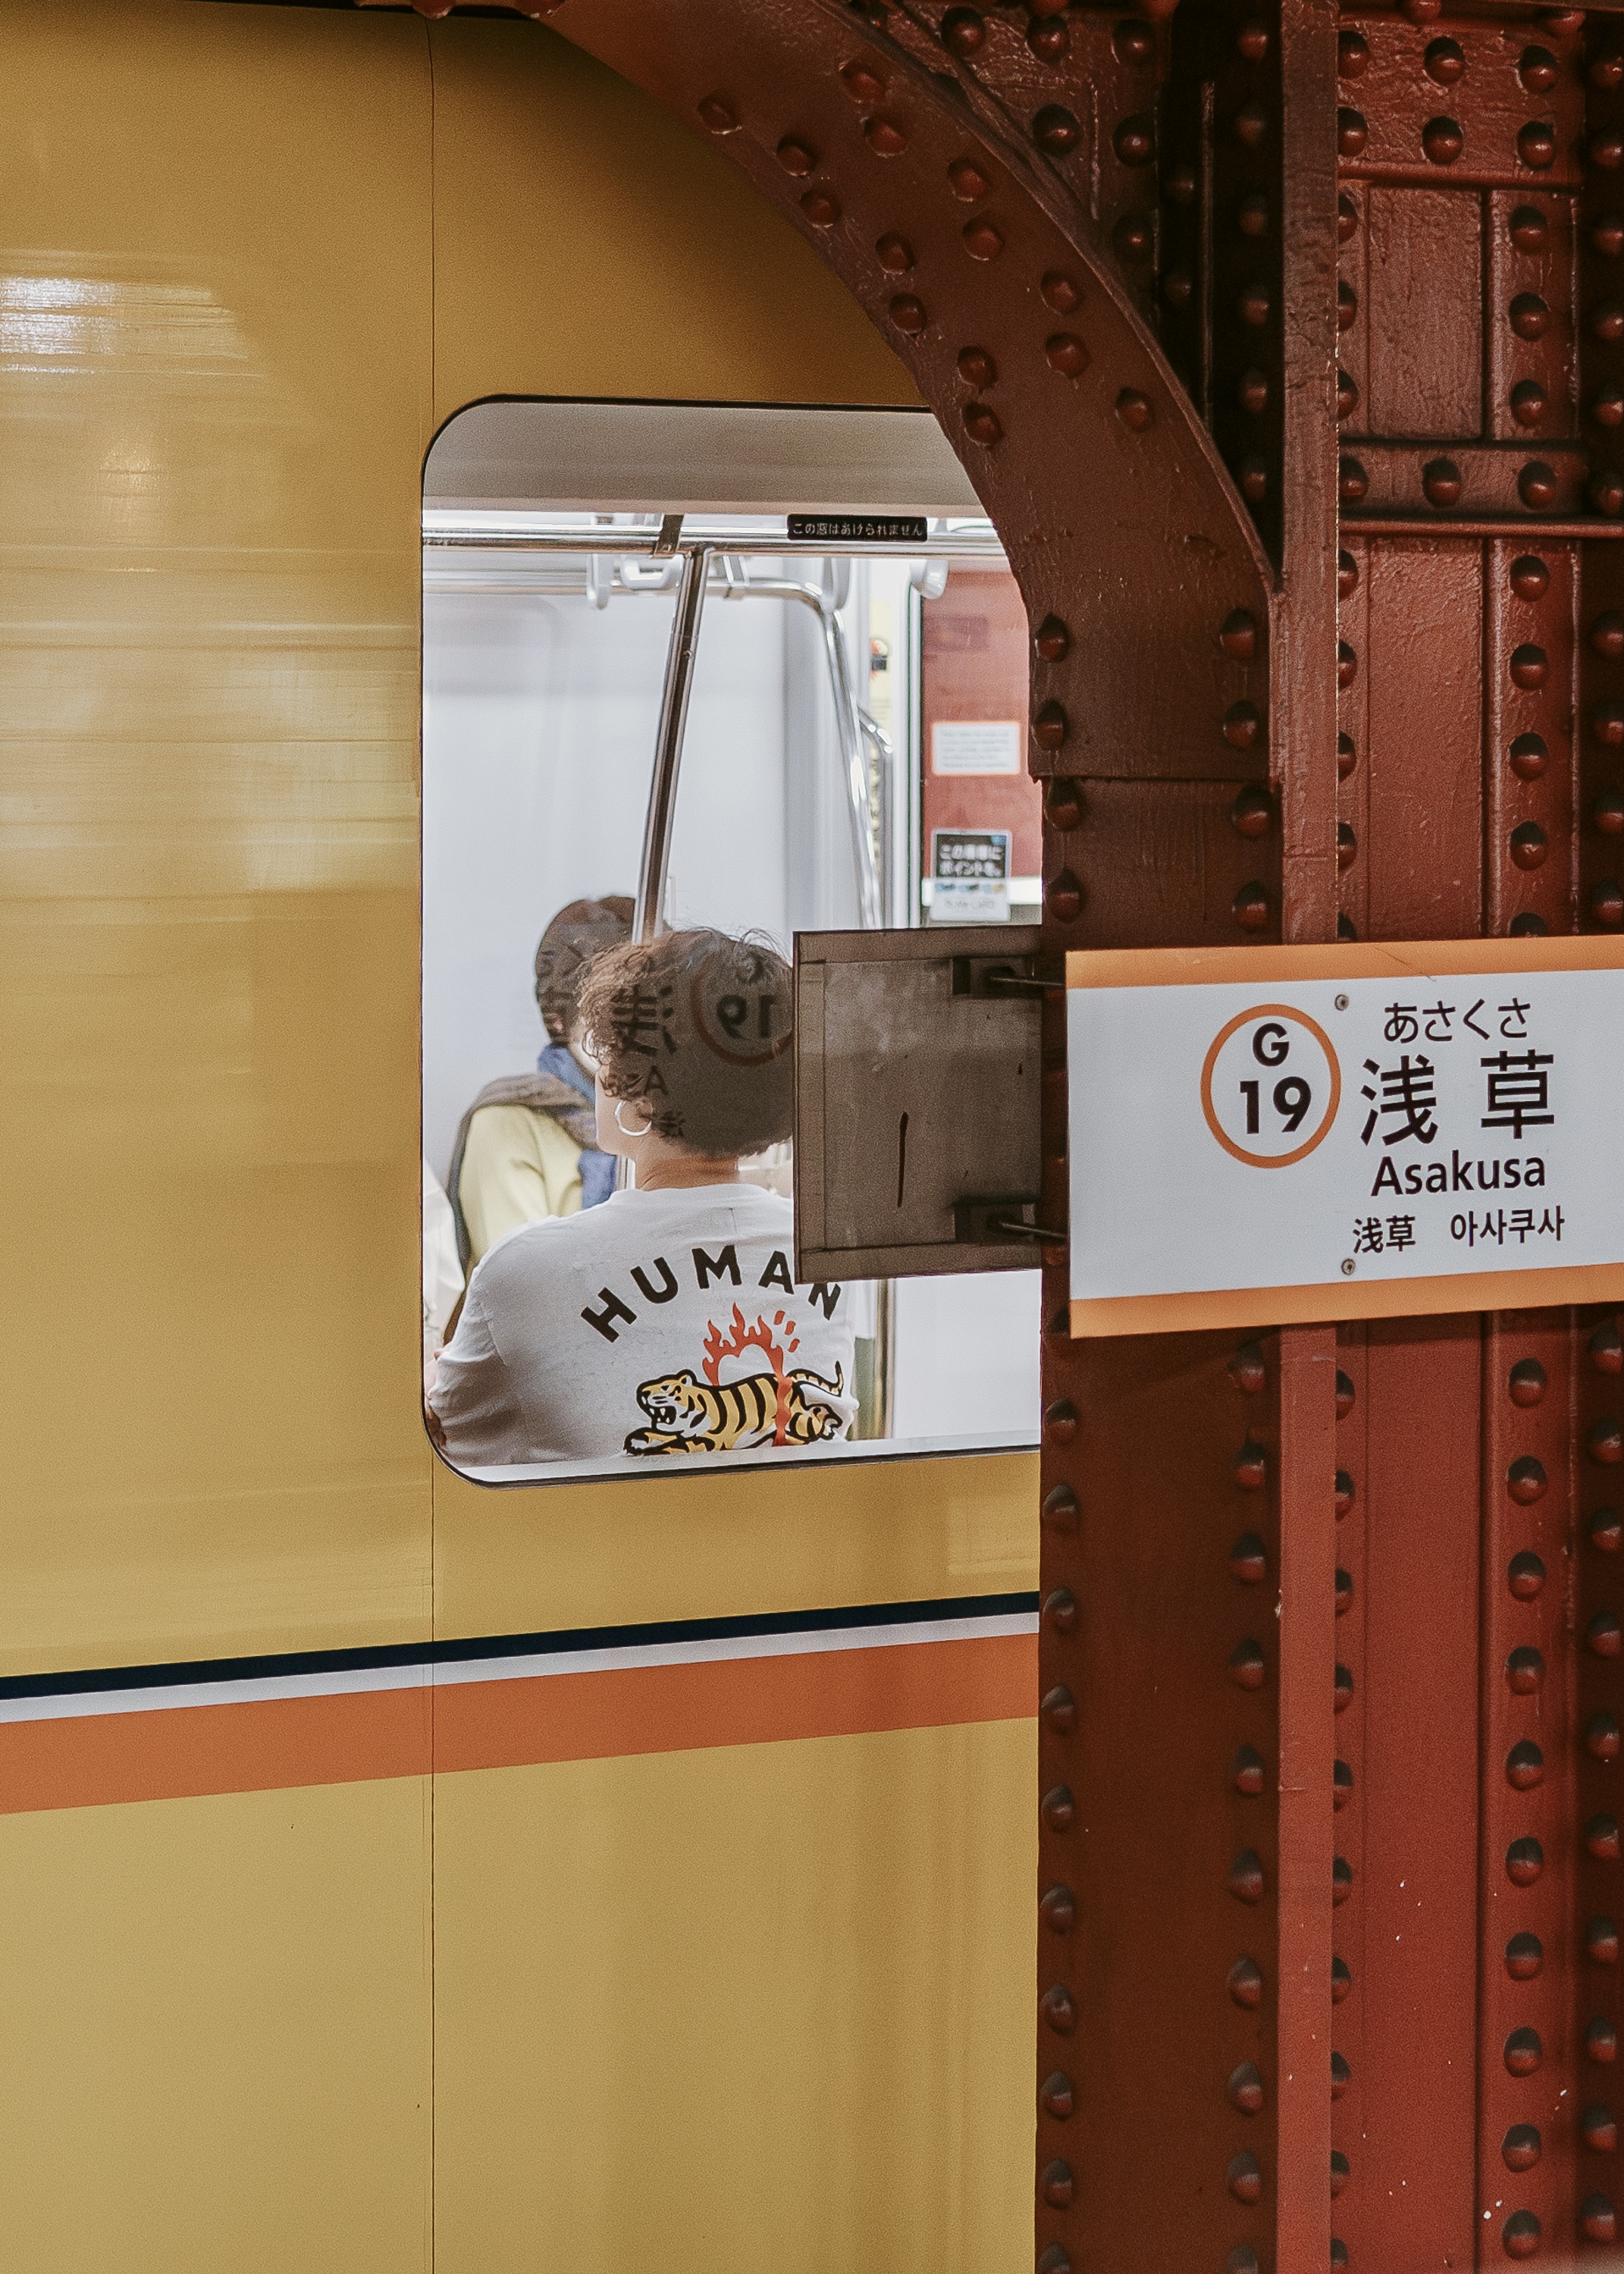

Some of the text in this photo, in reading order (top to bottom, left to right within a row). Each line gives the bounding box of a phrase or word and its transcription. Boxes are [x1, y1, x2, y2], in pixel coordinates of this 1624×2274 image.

[1384, 997, 1531, 1044] あさくさ
[1252, 1022, 1290, 1067] G
[1240, 1076, 1312, 1134] 19
[1361, 1049, 1554, 1146] 浅草
[1371, 1150, 1545, 1197] Asakusa
[1353, 1215, 1416, 1253] 浅草
[1450, 1206, 1566, 1247] 아사쿠사
[581, 1244, 842, 1343] HUMAN
